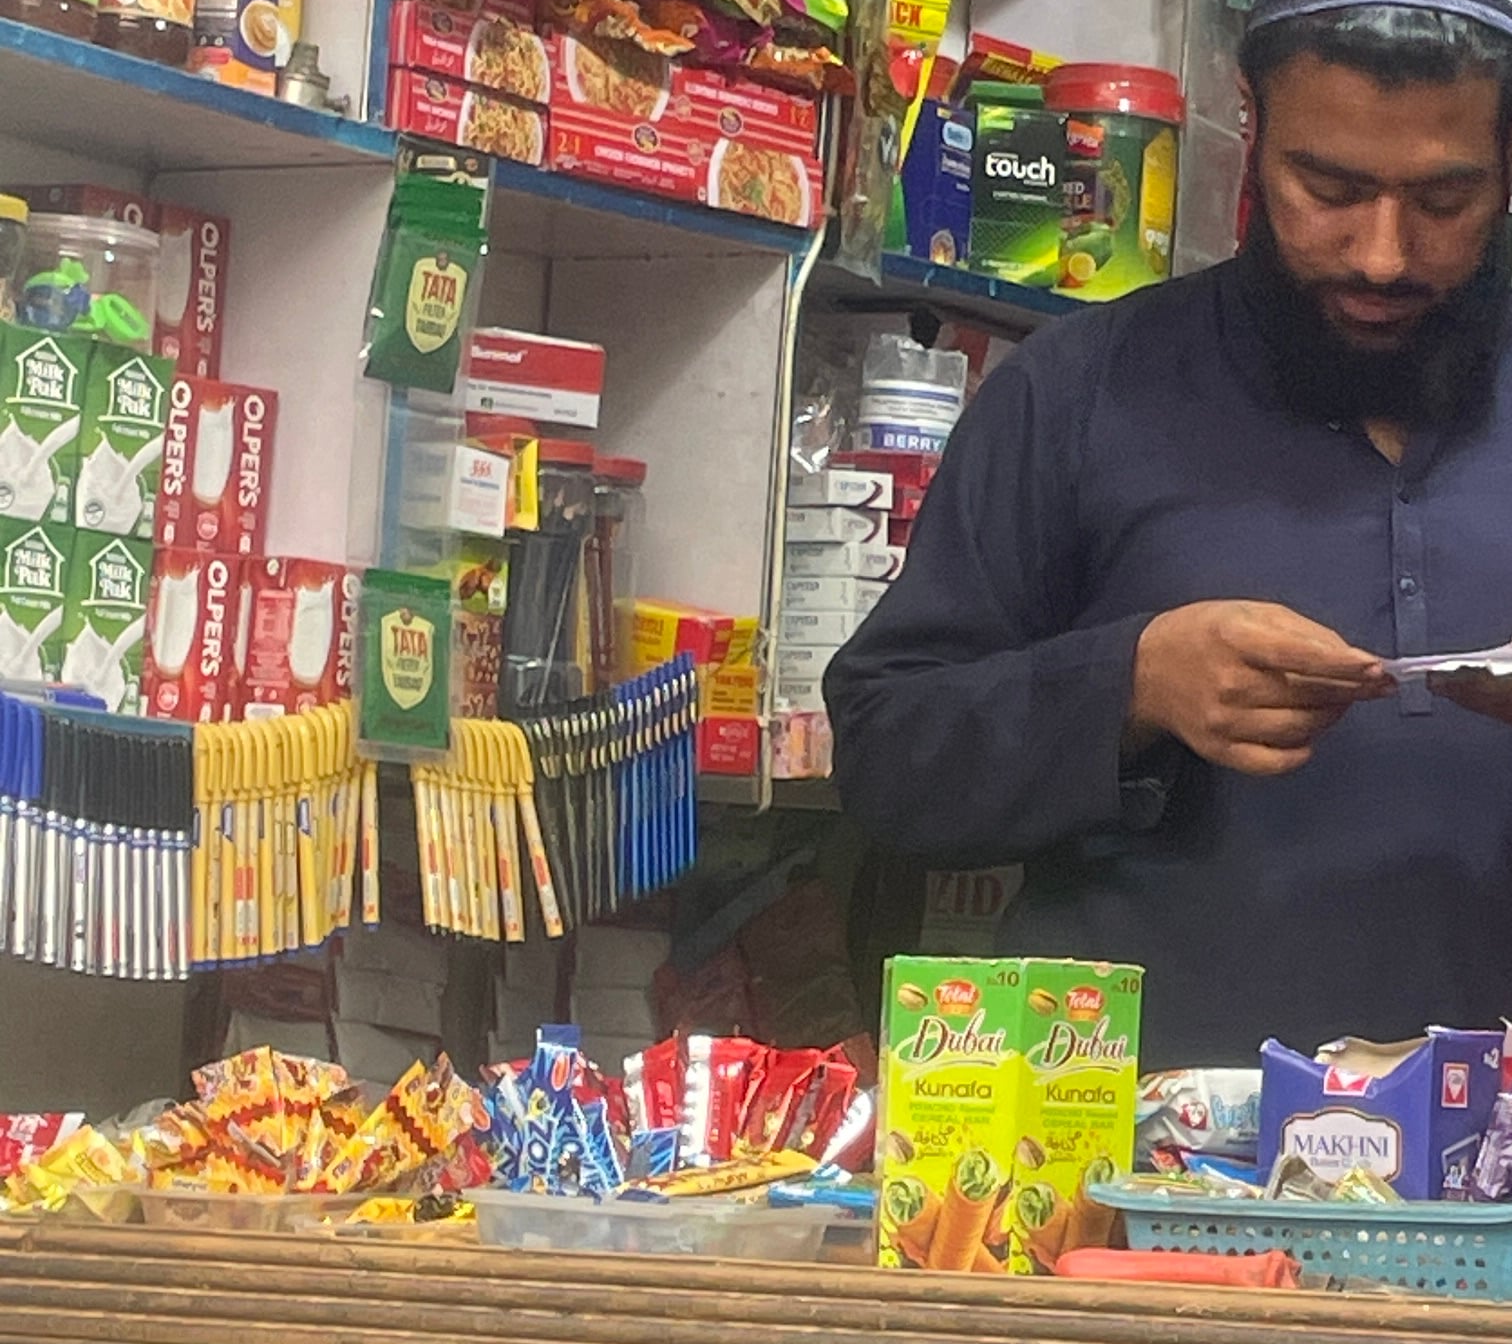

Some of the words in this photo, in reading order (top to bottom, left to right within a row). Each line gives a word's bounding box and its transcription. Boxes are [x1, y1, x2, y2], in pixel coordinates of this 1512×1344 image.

[985, 153, 1055, 186] touch
[420, 270, 458, 306] TATA
[26, 358, 65, 382] Milk
[27, 377, 65, 400] Pak
[117, 377, 153, 400] Milk
[117, 396, 151, 418] Pak
[163, 380, 193, 496] OLPER'S
[883, 433, 942, 452] BERRY
[238, 395, 266, 508] OLPER'S
[15, 549, 52, 571] Milk
[99, 561, 133, 582] Milk
[14, 567, 52, 589] Pak
[100, 580, 132, 601] Pak
[200, 560, 229, 677] OLPER'S
[391, 625, 428, 658] TATA
[912, 1009, 1005, 1064] Dubai
[1042, 1016, 1128, 1068] Dubai
[915, 1079, 992, 1099] Kunafa
[1046, 1084, 1116, 1104] Kunafa
[1294, 1134, 1390, 1157] MAKHNI
